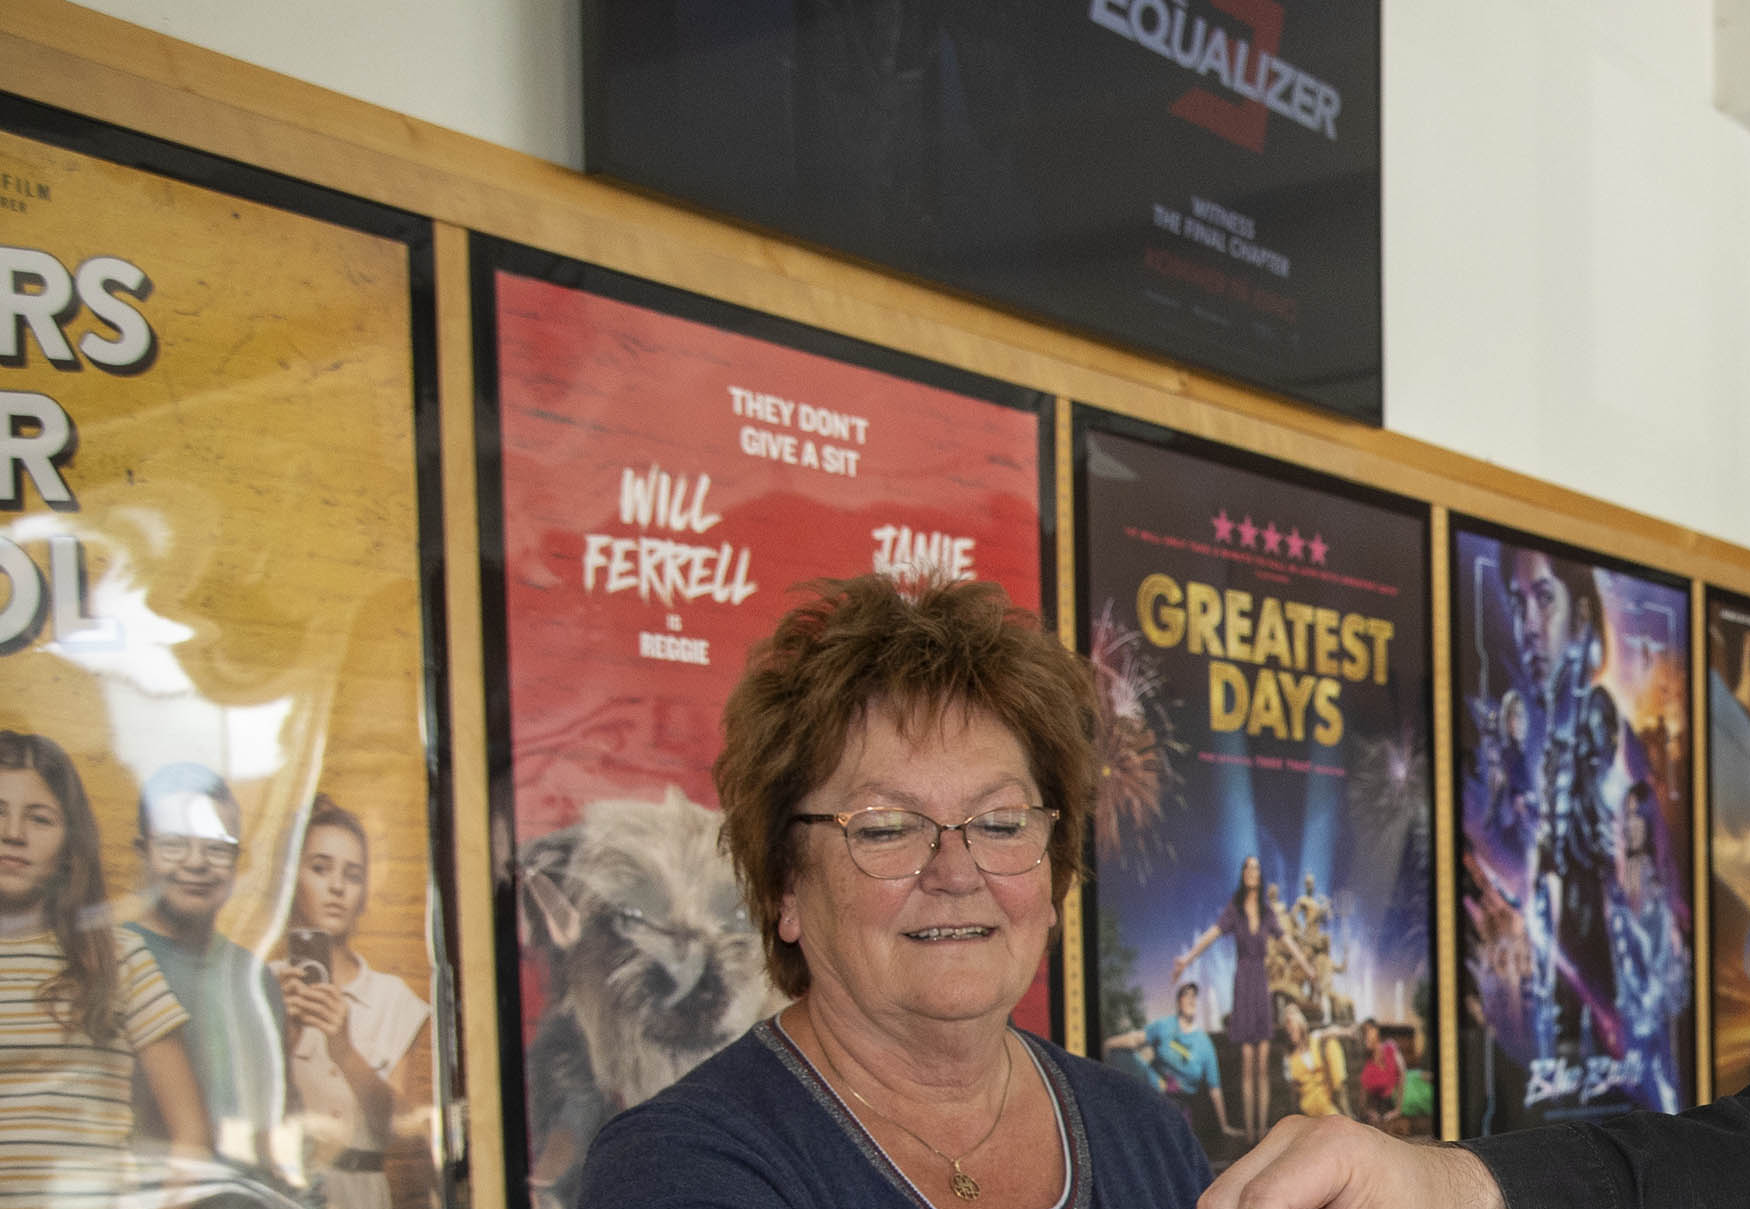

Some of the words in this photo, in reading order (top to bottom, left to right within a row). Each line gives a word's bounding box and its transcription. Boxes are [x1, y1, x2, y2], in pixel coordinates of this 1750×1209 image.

[1090, 0, 1341, 140] EQUALIZER
[728, 385, 795, 428] THEY
[798, 402, 869, 445] DON'T
[740, 424, 799, 465] GIVE
[801, 439, 820, 470] A
[821, 443, 861, 478] SIT
[619, 462, 723, 534] WILL
[584, 532, 758, 608] FERRELL
[872, 523, 977, 590] JAMIE
[639, 631, 711, 666] REGGIE
[1136, 573, 1394, 686] GREATEST
[1209, 660, 1344, 747] DAYS
